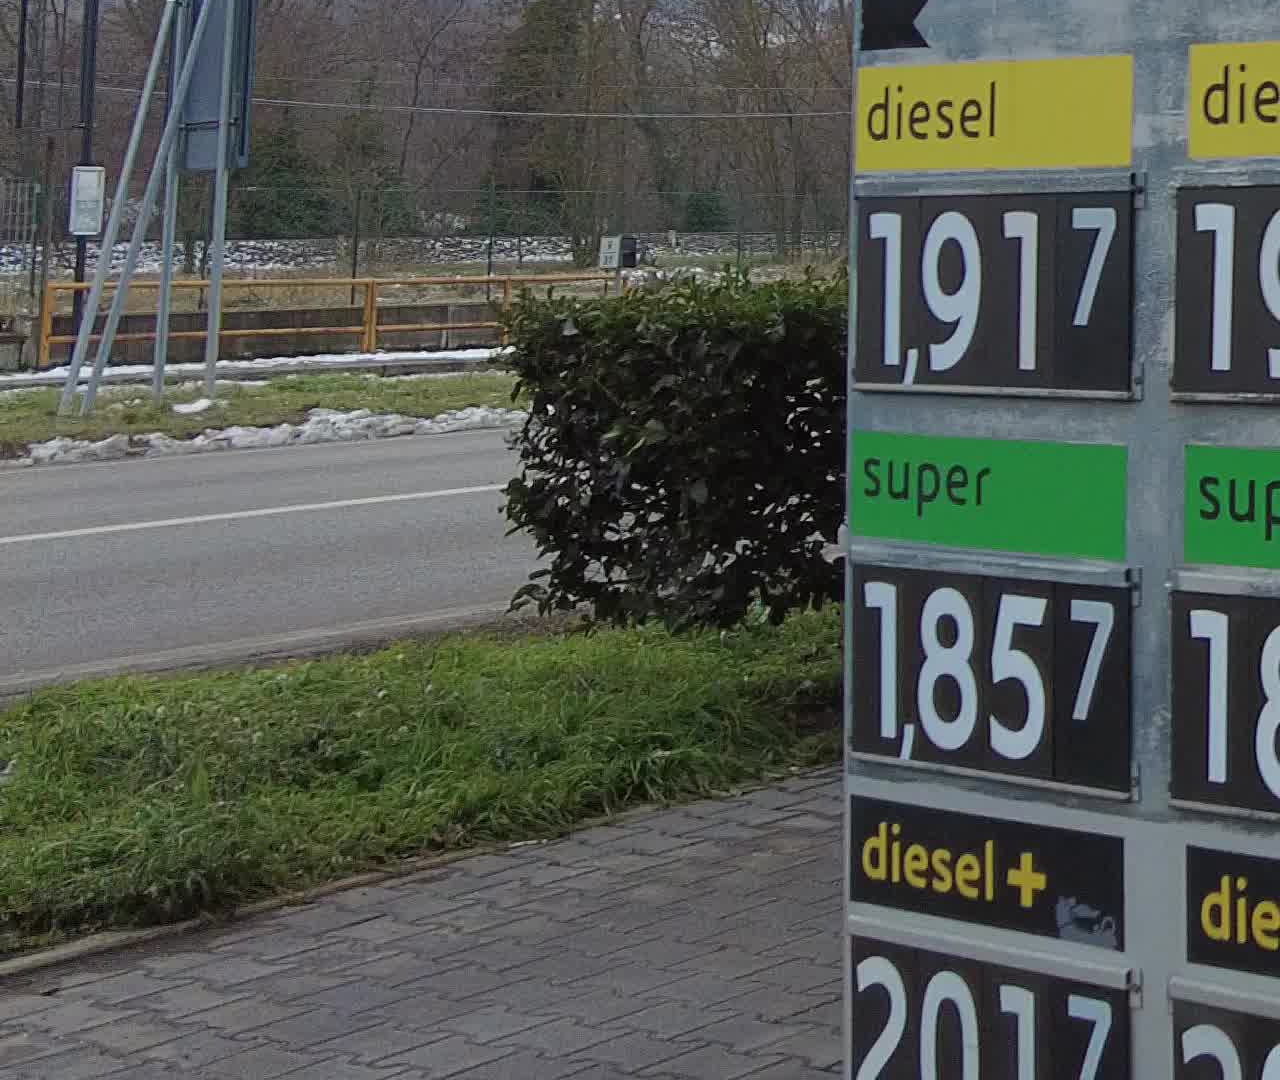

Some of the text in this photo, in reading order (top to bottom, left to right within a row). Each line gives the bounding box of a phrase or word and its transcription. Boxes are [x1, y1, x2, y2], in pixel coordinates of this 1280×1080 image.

[866, 81, 998, 142] diesel
[863, 456, 992, 516] super
[861, 822, 995, 902] diesel
